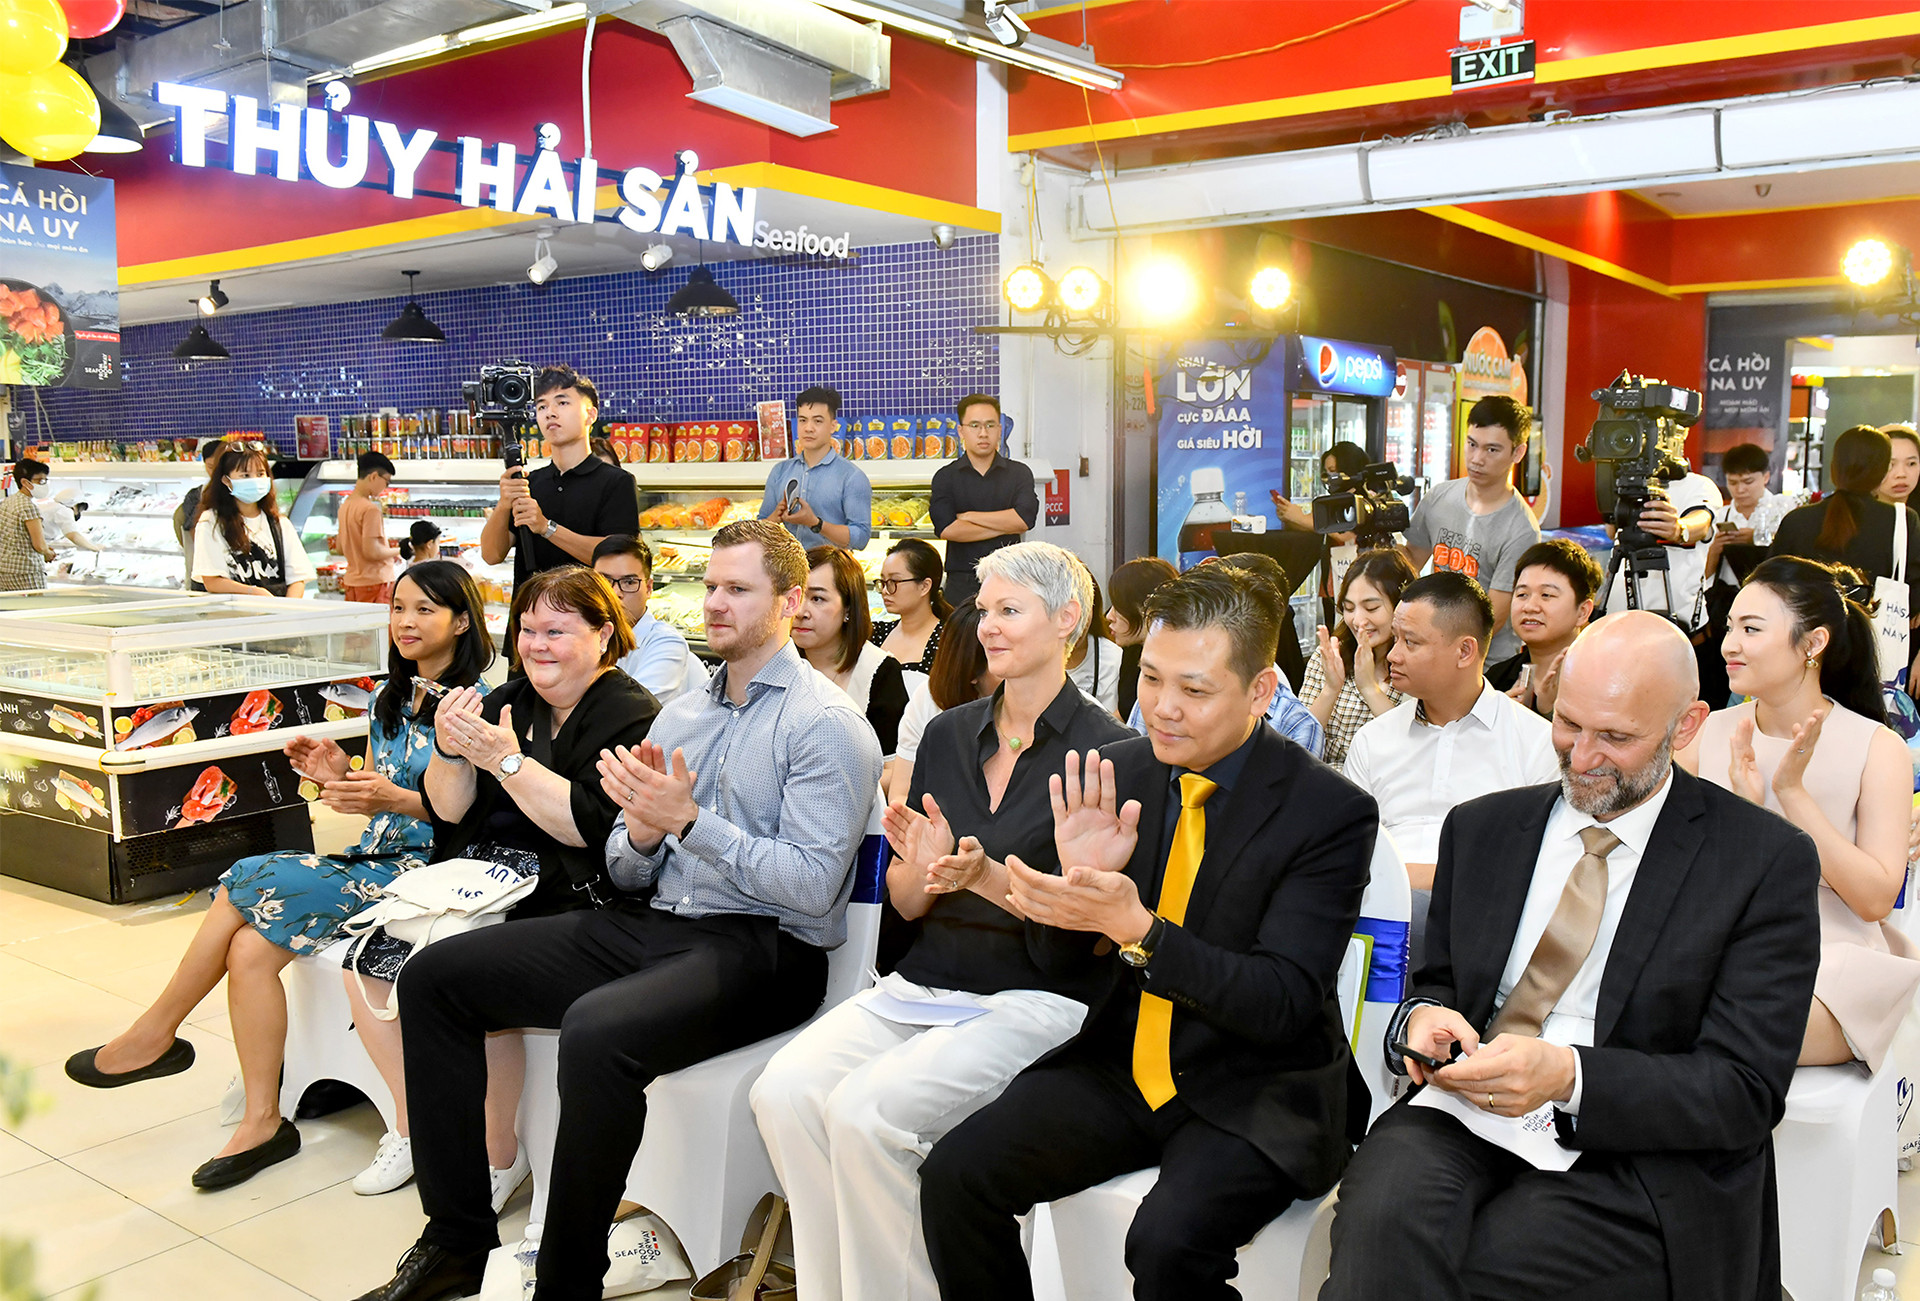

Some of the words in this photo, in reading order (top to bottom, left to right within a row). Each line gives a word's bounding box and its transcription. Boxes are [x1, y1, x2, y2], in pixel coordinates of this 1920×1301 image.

[1459, 46, 1525, 82] EXIT
[156, 80, 438, 199] THỦY
[460, 122, 598, 224] HẢI
[618, 149, 757, 247] SẢN
[38, 184, 88, 215] HỒI
[0, 212, 35, 236] NA
[43, 217, 80, 240] UY
[754, 220, 850, 258] Seafood
[1343, 354, 1383, 385] pepsi
[1709, 354, 1733, 372] CÁ
[1737, 352, 1771, 372] HỒI
[1711, 376, 1736, 391] NA
[1741, 376, 1768, 391] UY
[1177, 411, 1200, 425] CỰC
[1177, 436, 1196, 449] GIÁ
[1196, 436, 1220, 449] SIÊU
[1222, 424, 1262, 449] HỜI
[1045, 502, 1064, 513] PCCC
[614, 1248, 661, 1258] SEAFOOD
[637, 1242, 650, 1265] FROM
[640, 1229, 657, 1262] NORWAY
